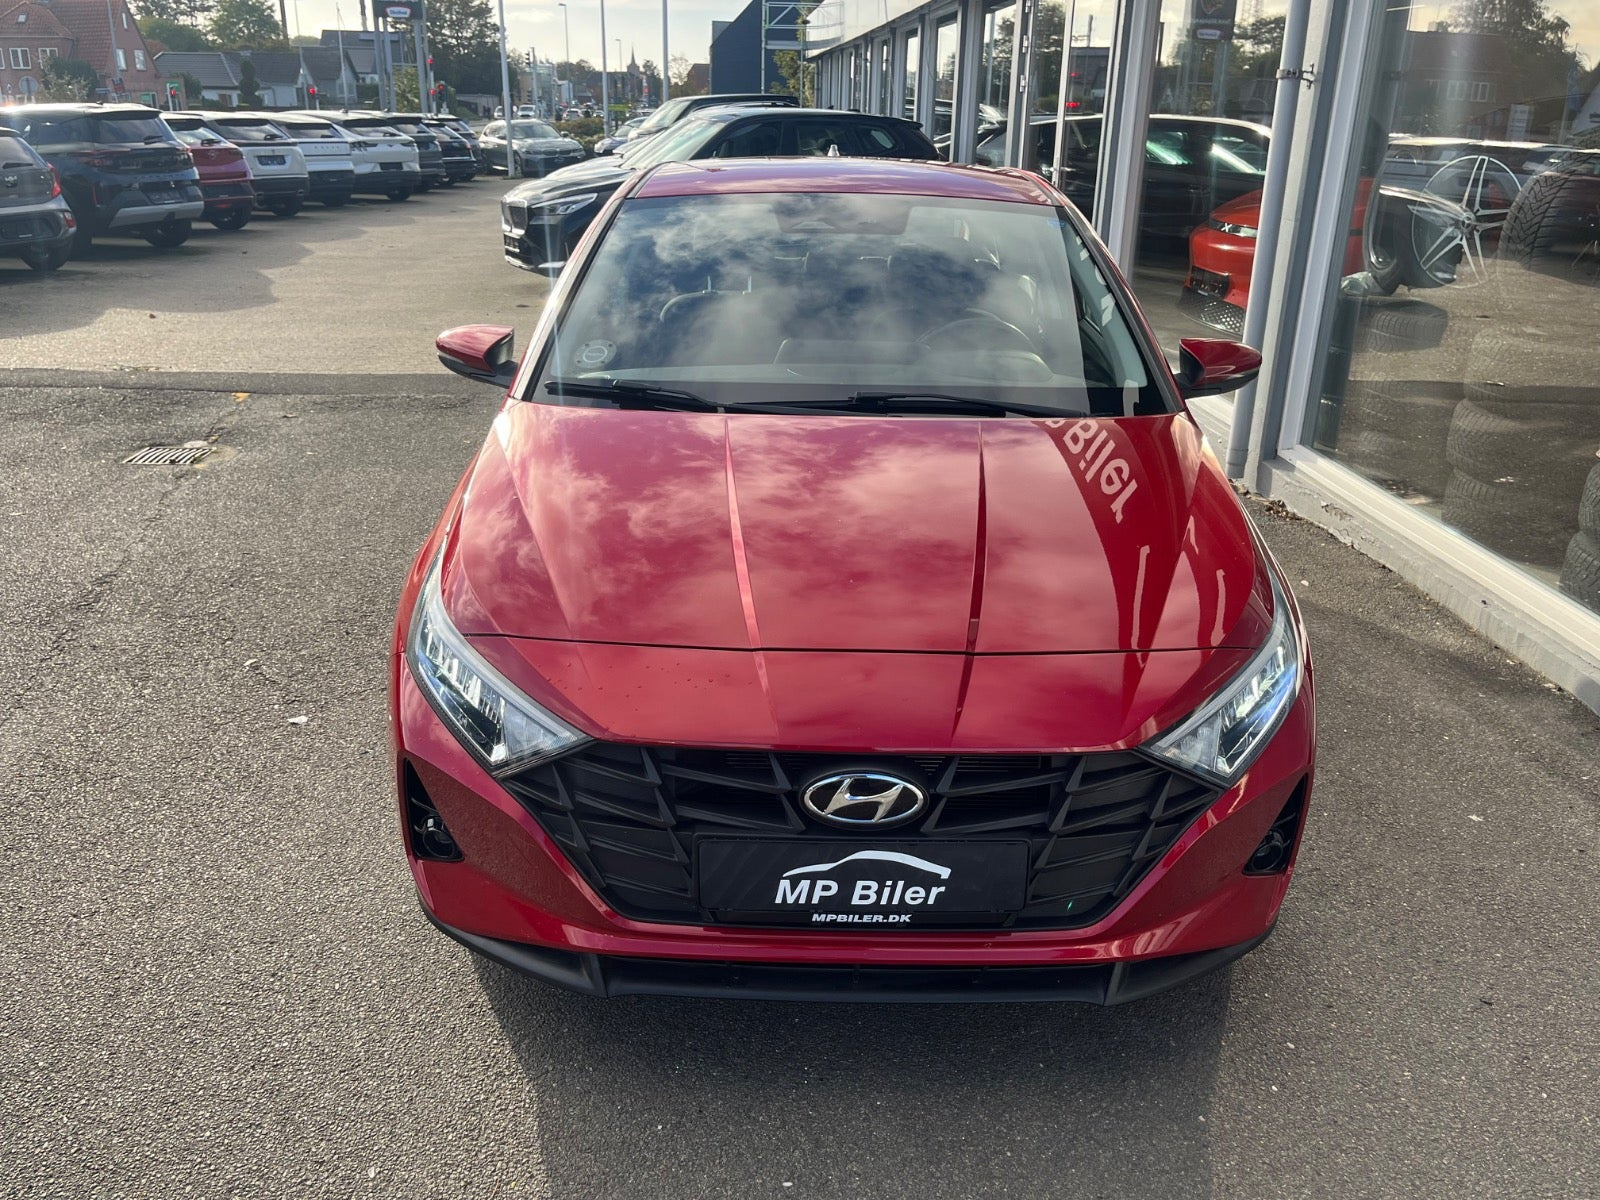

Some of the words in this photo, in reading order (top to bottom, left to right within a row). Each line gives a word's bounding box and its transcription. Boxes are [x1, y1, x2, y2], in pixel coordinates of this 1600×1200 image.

[775, 879, 837, 904] MP
[851, 881, 946, 905] Biler
[811, 913, 912, 923] MPBILER.DK
